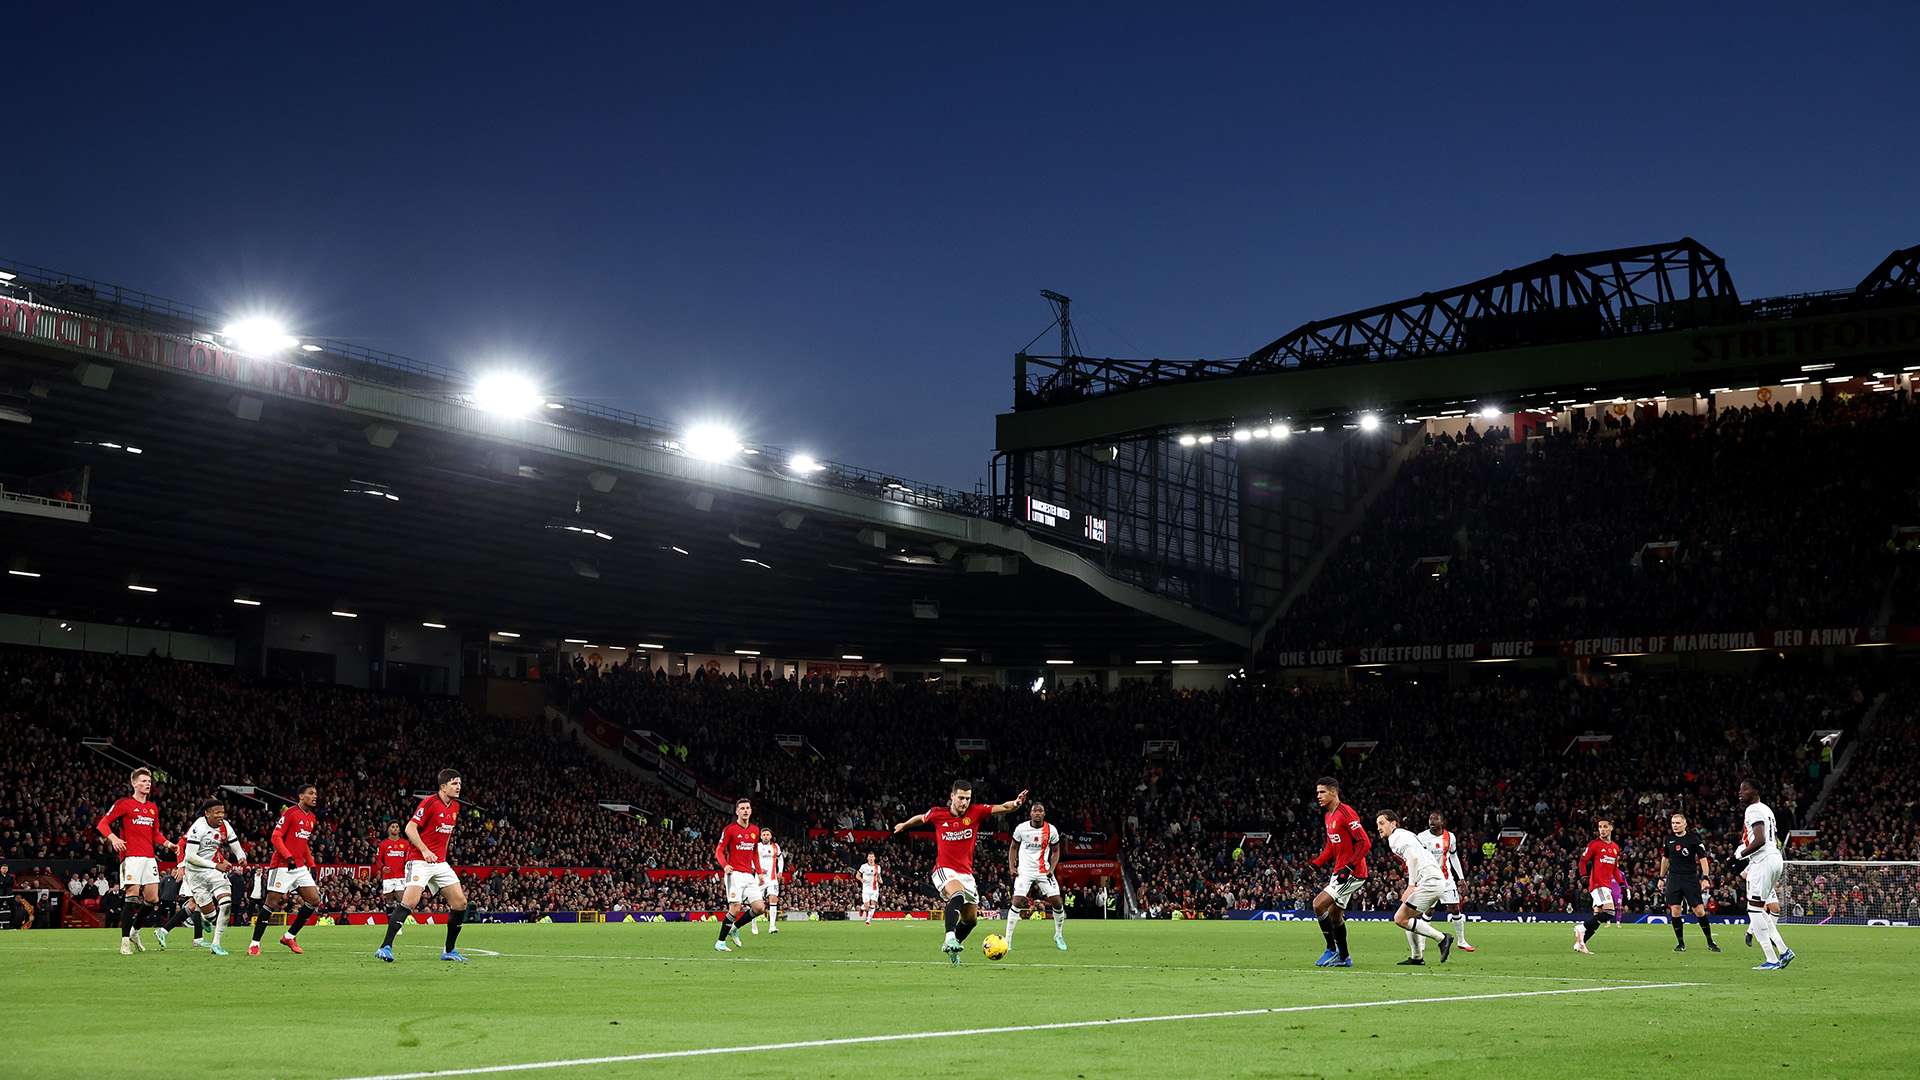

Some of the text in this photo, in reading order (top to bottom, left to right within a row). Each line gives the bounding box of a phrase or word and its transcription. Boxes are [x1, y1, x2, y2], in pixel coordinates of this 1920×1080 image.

[1491, 641, 1534, 657] MUFC
[1649, 635, 1667, 652] OF
[1279, 649, 1343, 666] ONE LOVE
[1360, 643, 1474, 662] STRETFORD END
